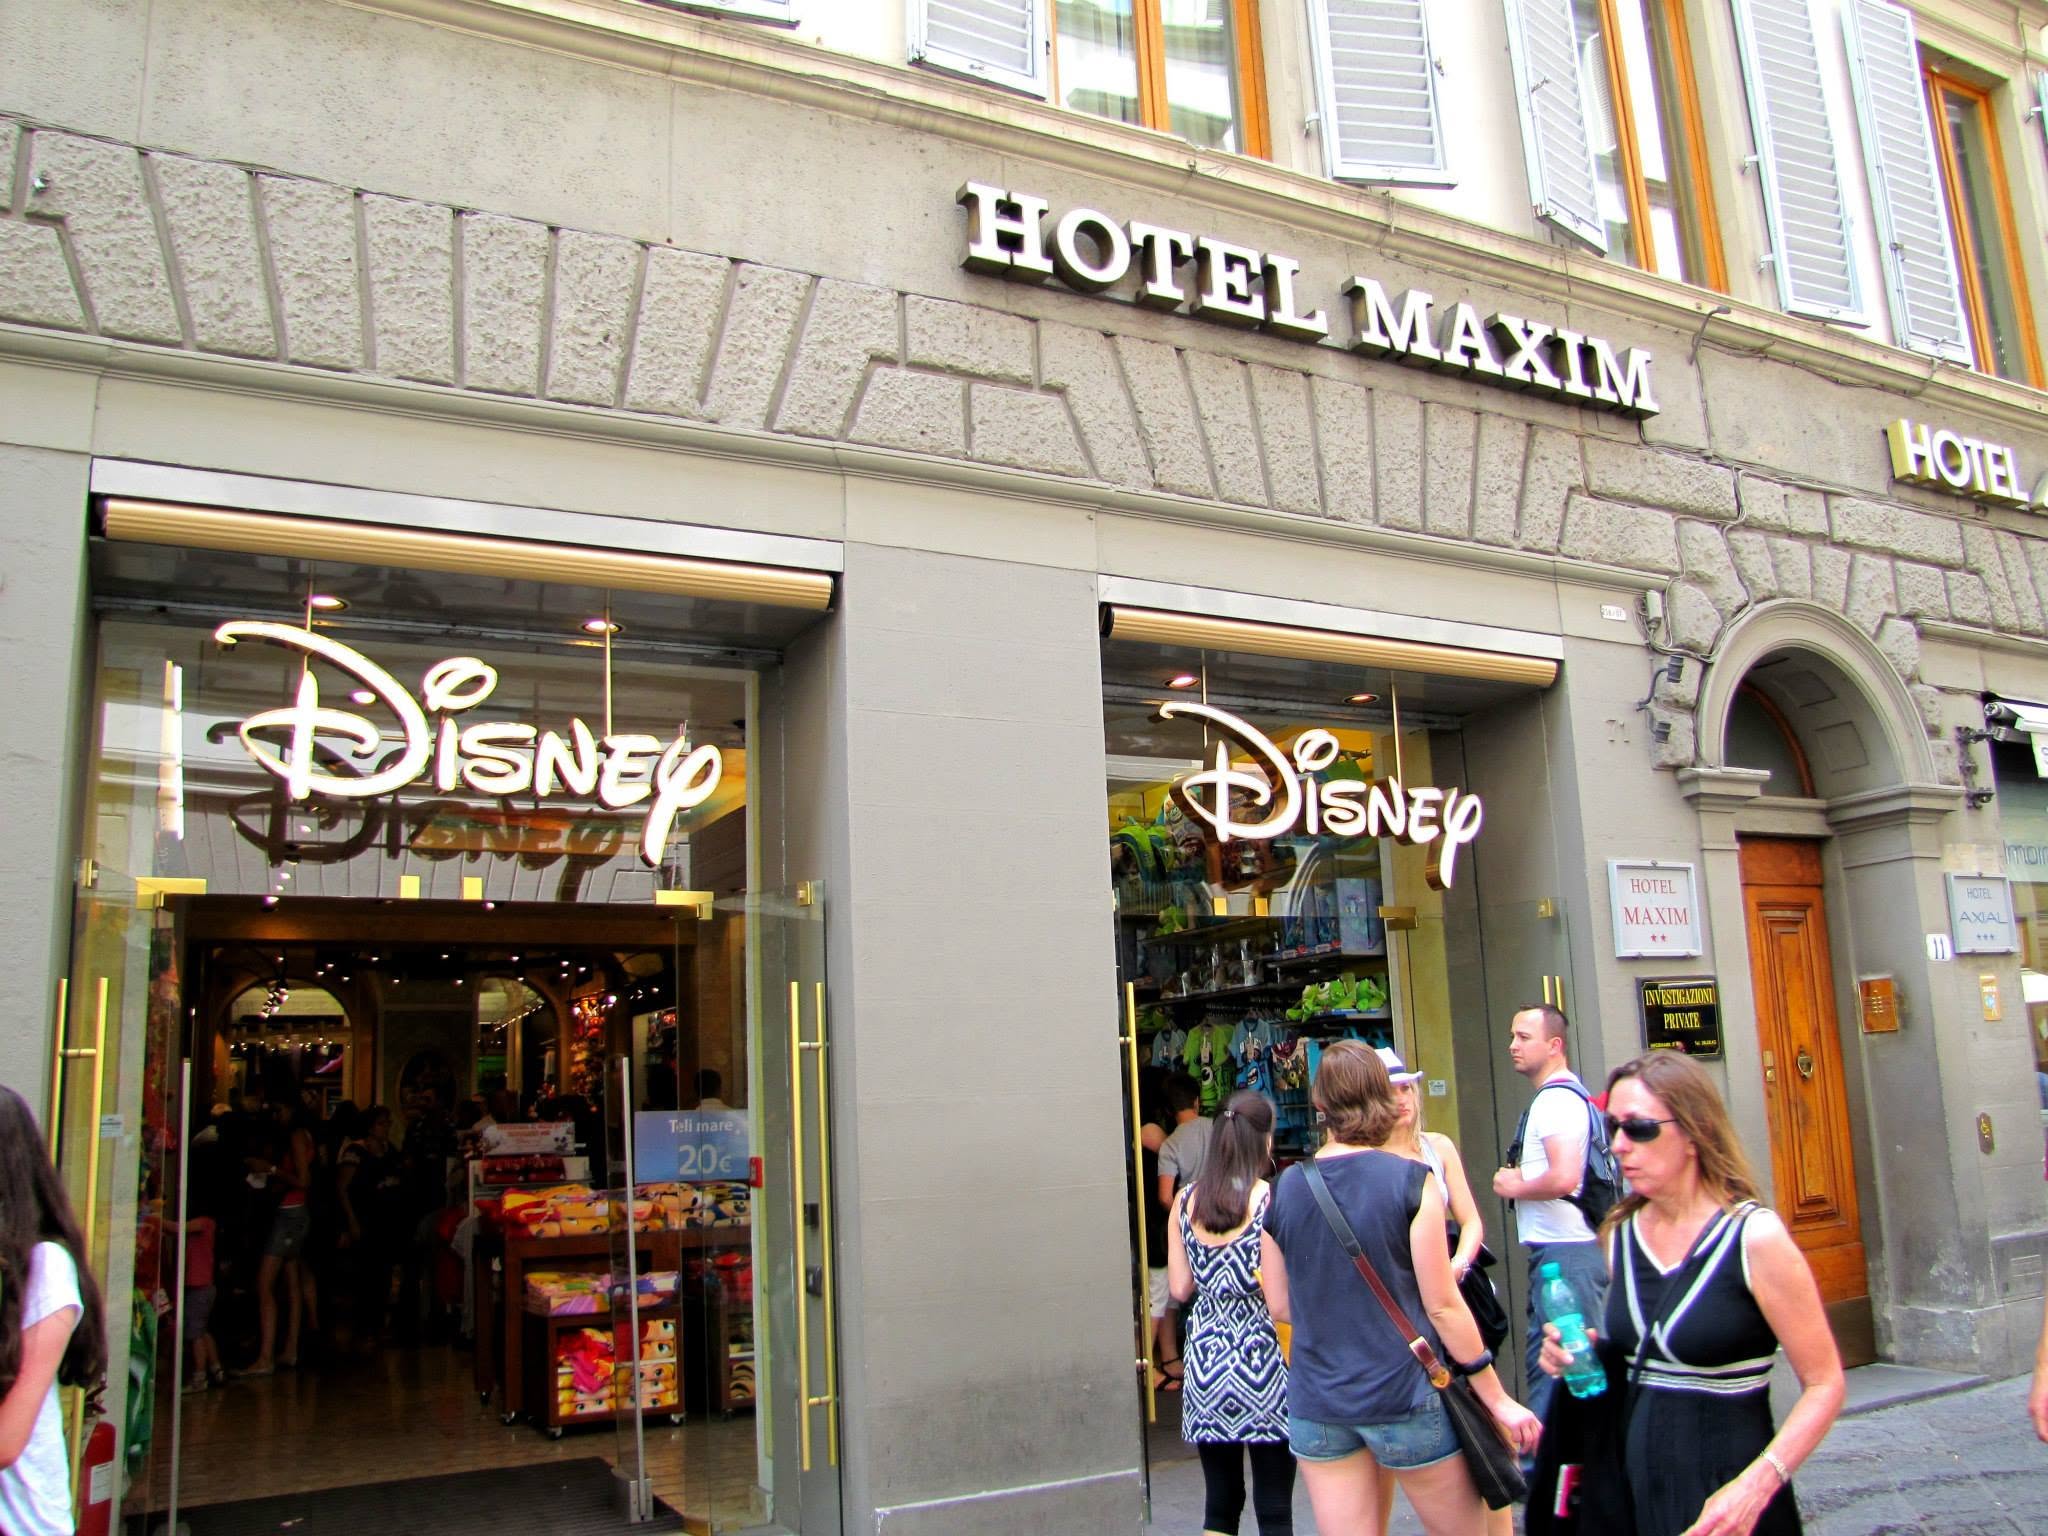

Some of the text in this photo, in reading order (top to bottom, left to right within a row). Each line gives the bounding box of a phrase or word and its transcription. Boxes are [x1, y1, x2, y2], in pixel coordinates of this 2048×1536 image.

[958, 181, 1660, 415] HOTEL MAXIM
[1893, 418, 2030, 502] HOTEL
[1631, 878, 1677, 894] HOTEL
[1966, 887, 1993, 900] HOTEL
[1624, 906, 1688, 926] MAXIM
[1960, 911, 2009, 924] AXIAL
[1933, 937, 1945, 960] 11
[1645, 988, 1714, 1006] INVESTIGAZIONI
[1664, 1012, 1701, 1029] PRIVATE
[669, 1119, 733, 1133] Teli mare
